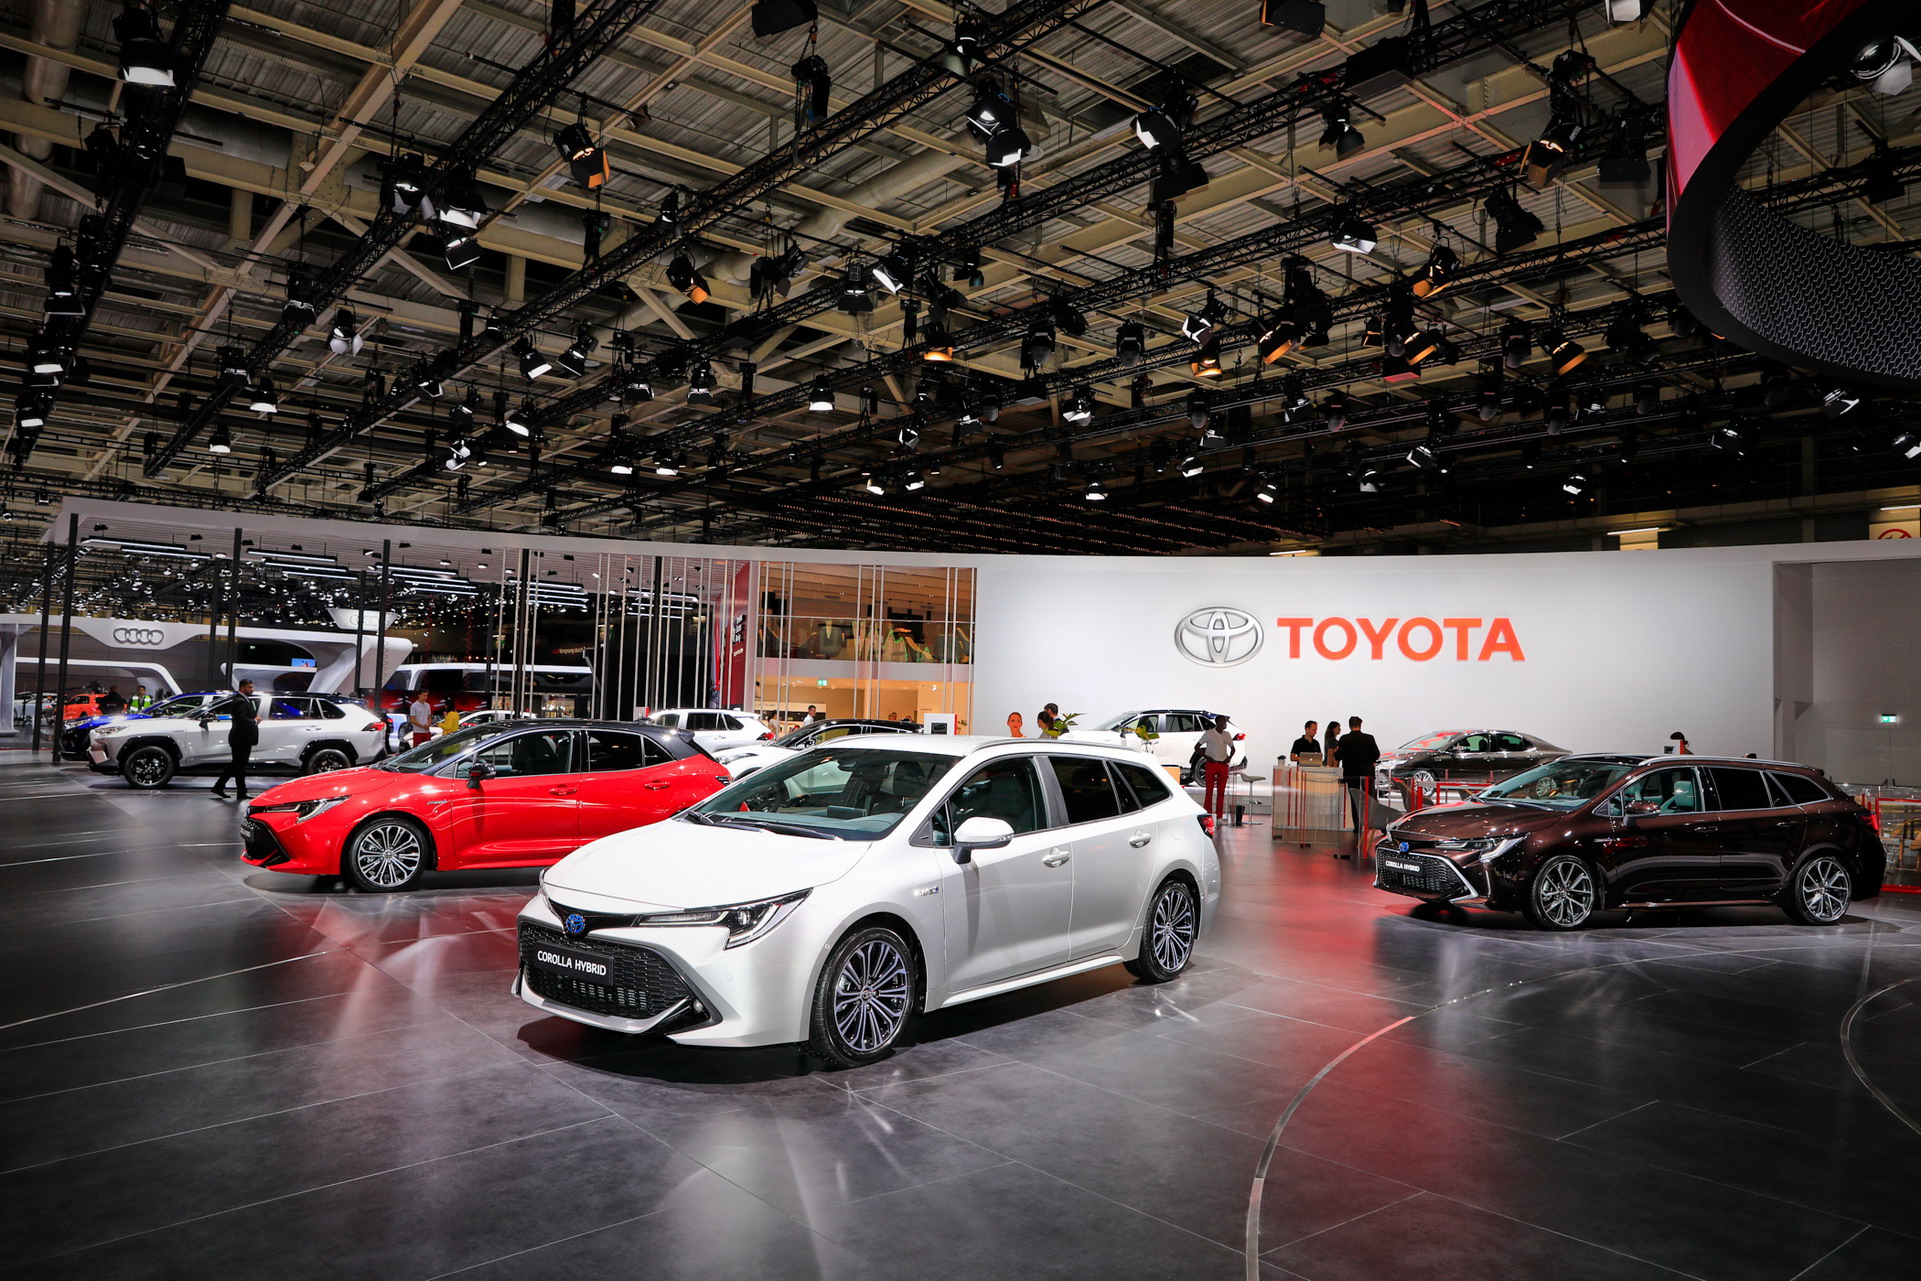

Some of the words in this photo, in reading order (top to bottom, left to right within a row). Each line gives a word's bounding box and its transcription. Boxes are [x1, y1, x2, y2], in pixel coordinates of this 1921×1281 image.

[1277, 616, 1526, 662] TOYOTA
[537, 950, 572, 968] COROLLA
[574, 959, 606, 975] HYBRID
